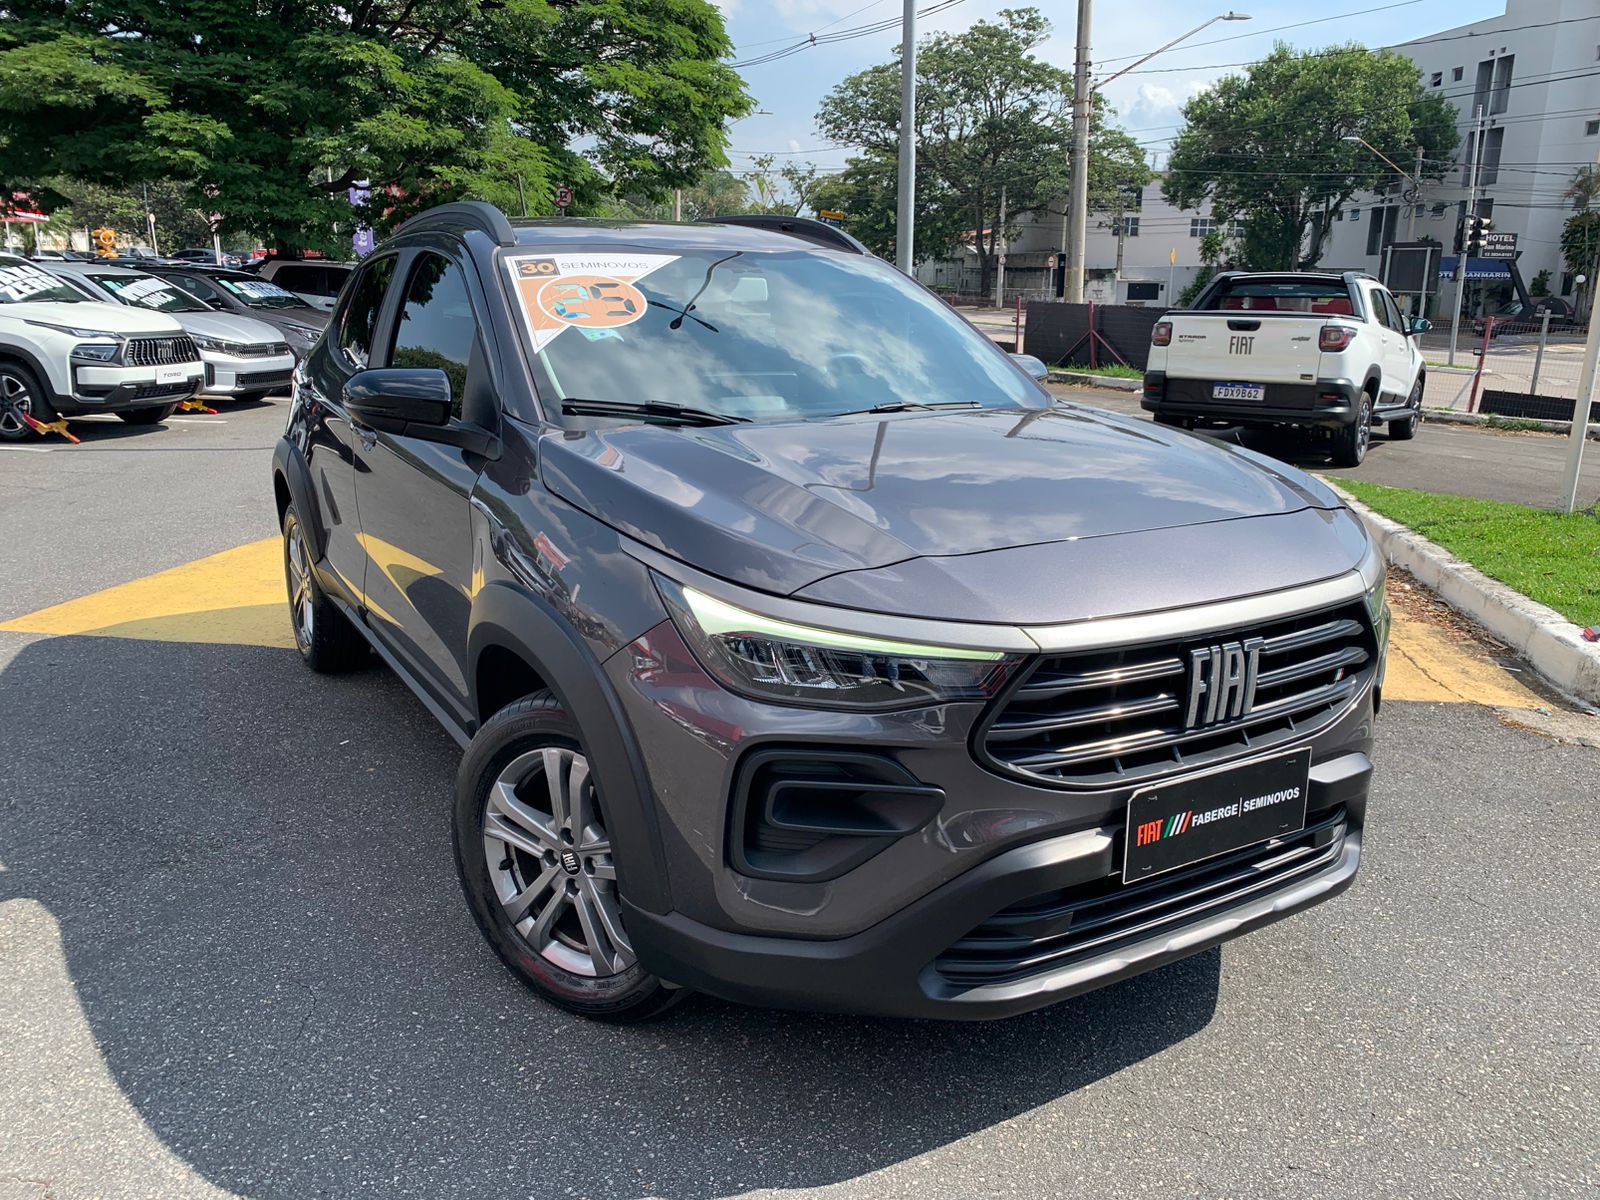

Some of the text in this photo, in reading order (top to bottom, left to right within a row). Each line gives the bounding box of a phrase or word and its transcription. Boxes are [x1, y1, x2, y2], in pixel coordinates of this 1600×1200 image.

[1485, 234, 1515, 242] HOTEL
[521, 260, 649, 274] 30 SEMINOVOS
[0, 275, 64, 301] ZERO
[553, 282, 638, 319] 25
[1229, 335, 1256, 355] FIAT
[1217, 387, 1260, 399] FDX9B62
[1184, 636, 1266, 729] FIAT
[1136, 787, 1301, 847] FIAT FABERGE SEMINOVOS
[562, 852, 578, 872] FIAT
